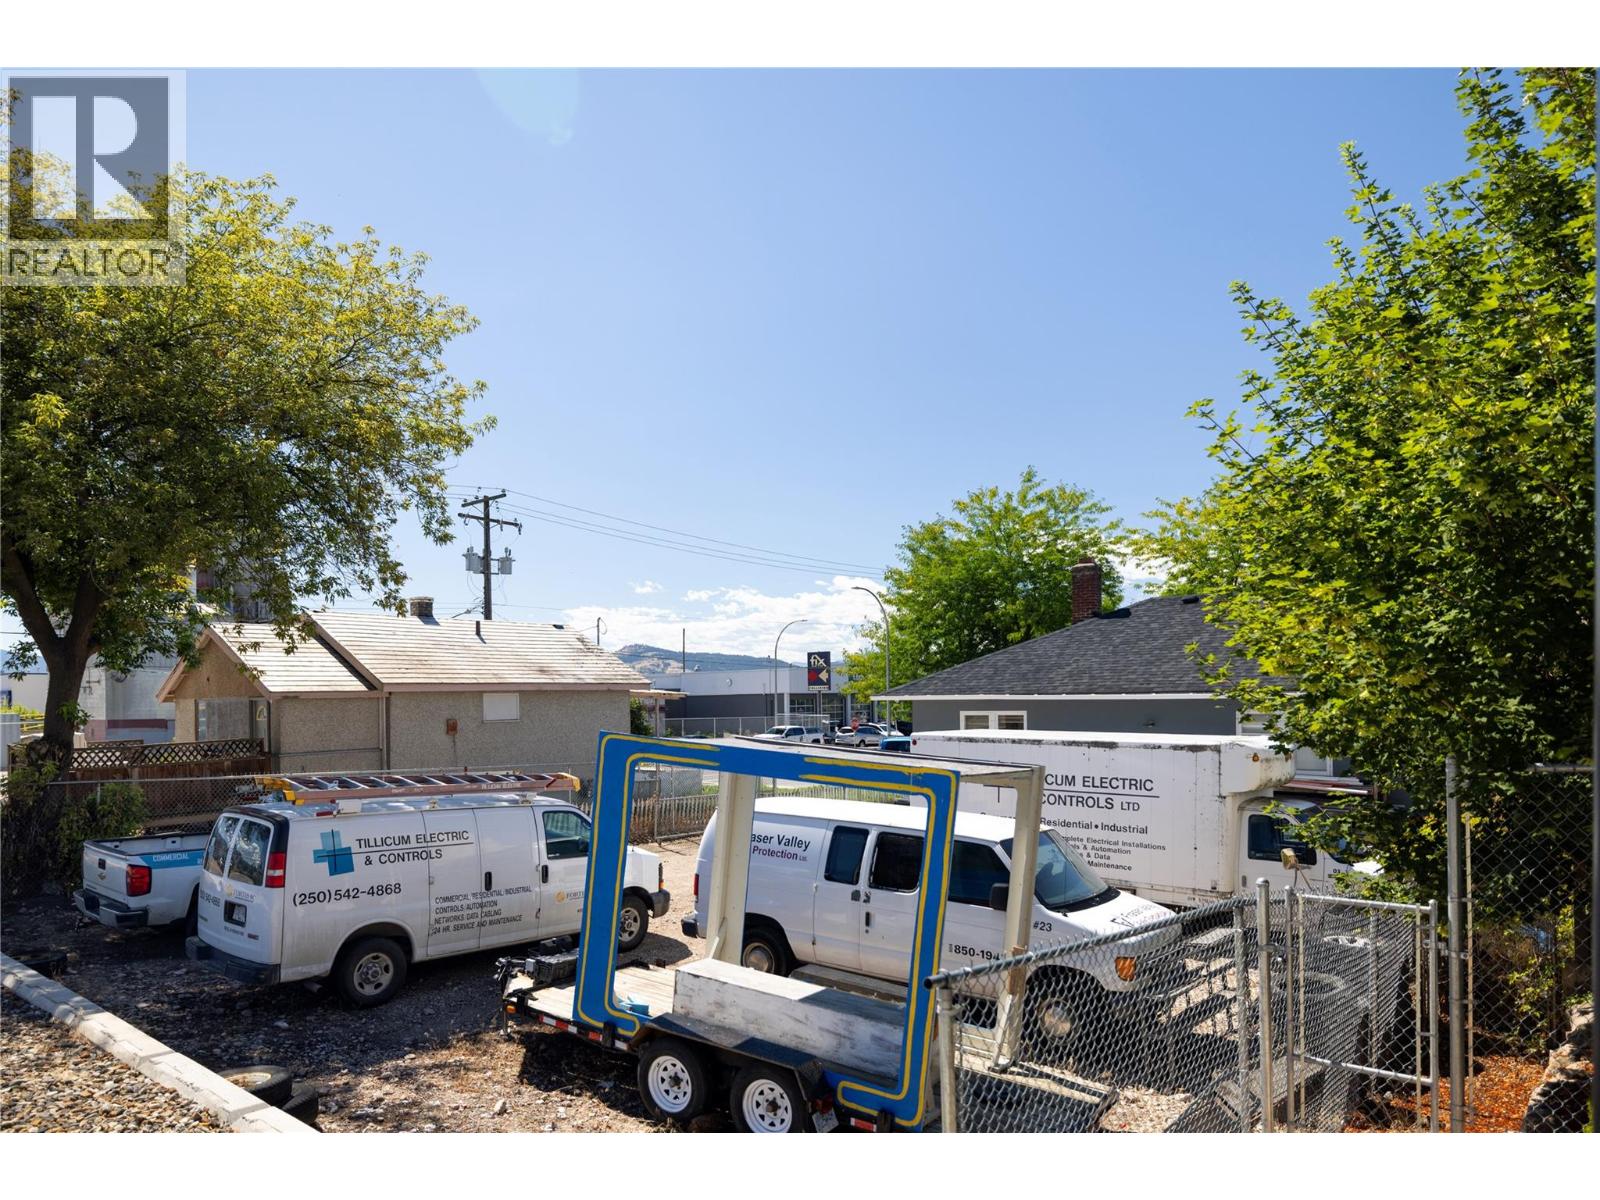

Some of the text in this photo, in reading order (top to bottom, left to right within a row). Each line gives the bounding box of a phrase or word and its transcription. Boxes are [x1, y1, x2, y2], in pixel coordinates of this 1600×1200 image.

[1082, 776, 1154, 792] ELECTRIC
[1120, 801, 1140, 812] LTD
[1100, 822, 1148, 835] Industrial
[356, 830, 470, 850] TILLICUM ELECTRIC
[777, 834, 811, 852] Valley
[1086, 837, 1119, 847] Electrical
[1121, 840, 1167, 851] Installations
[752, 845, 798, 860] Protection
[1091, 845, 1132, 855] Automation
[152, 853, 189, 862] COMMERCIAL
[364, 849, 443, 866] & CONTROLS
[1087, 860, 1133, 871] Maintenance
[1033, 920, 1053, 932] #23
